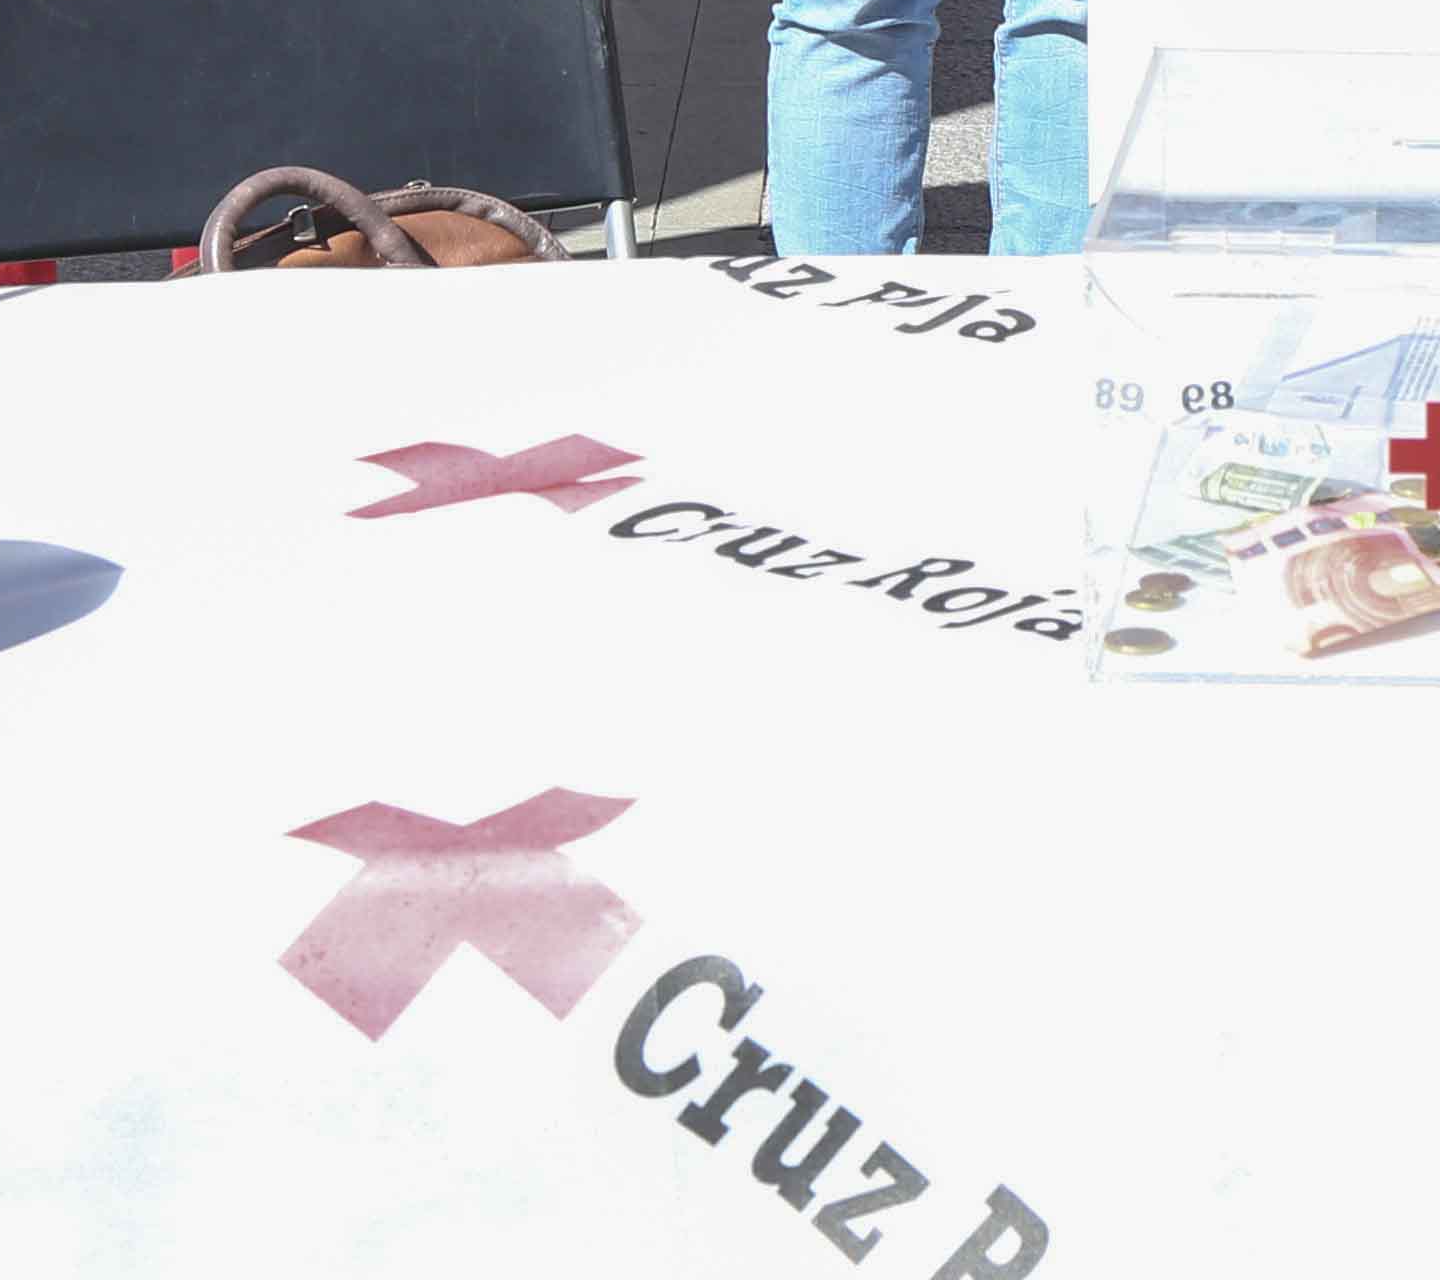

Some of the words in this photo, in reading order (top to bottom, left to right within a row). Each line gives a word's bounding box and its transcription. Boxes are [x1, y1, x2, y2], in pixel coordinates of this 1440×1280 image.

[608, 501, 862, 580] Cruz
[841, 557, 1084, 641] Roja
[613, 954, 932, 1266] Cruz
